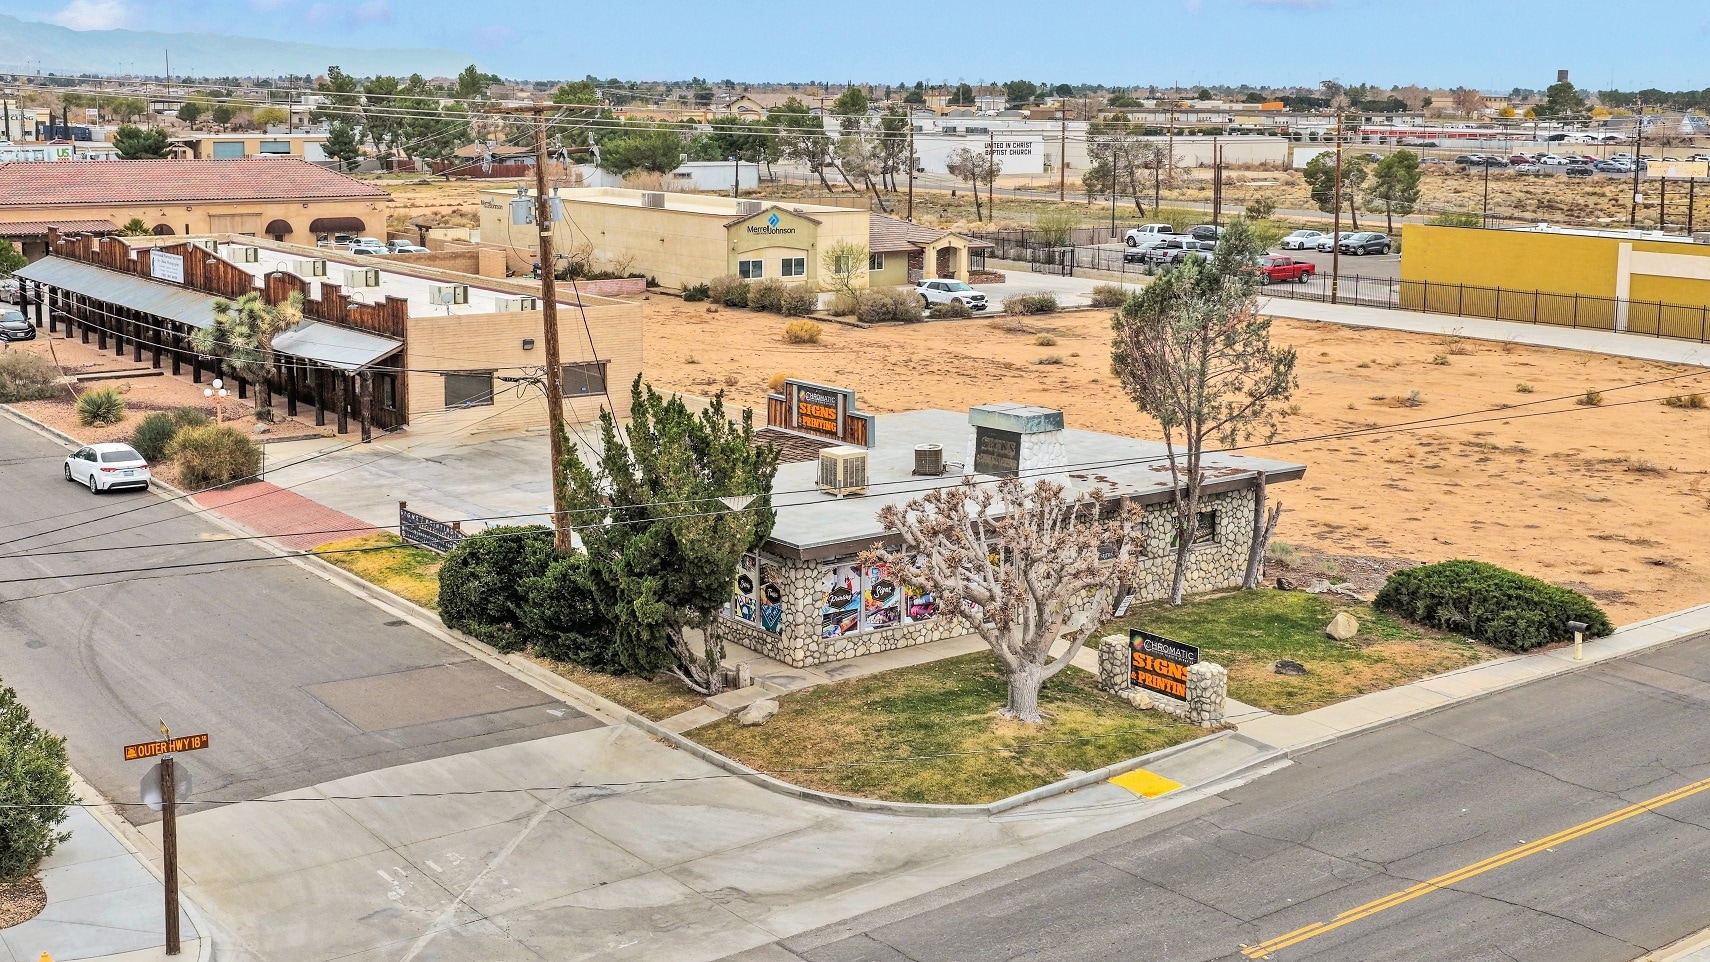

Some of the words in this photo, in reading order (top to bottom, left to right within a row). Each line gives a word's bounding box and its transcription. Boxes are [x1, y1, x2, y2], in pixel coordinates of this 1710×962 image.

[768, 227, 796, 235] Johnson
[799, 402, 837, 419] SIGNS
[802, 415, 837, 432] PRINTING
[1143, 639, 1194, 660] CHROMATIC
[1137, 670, 1187, 697] PRINTIN
[138, 742, 167, 757] OUTER
[169, 738, 190, 752] HWY
[191, 737, 201, 749] 18
